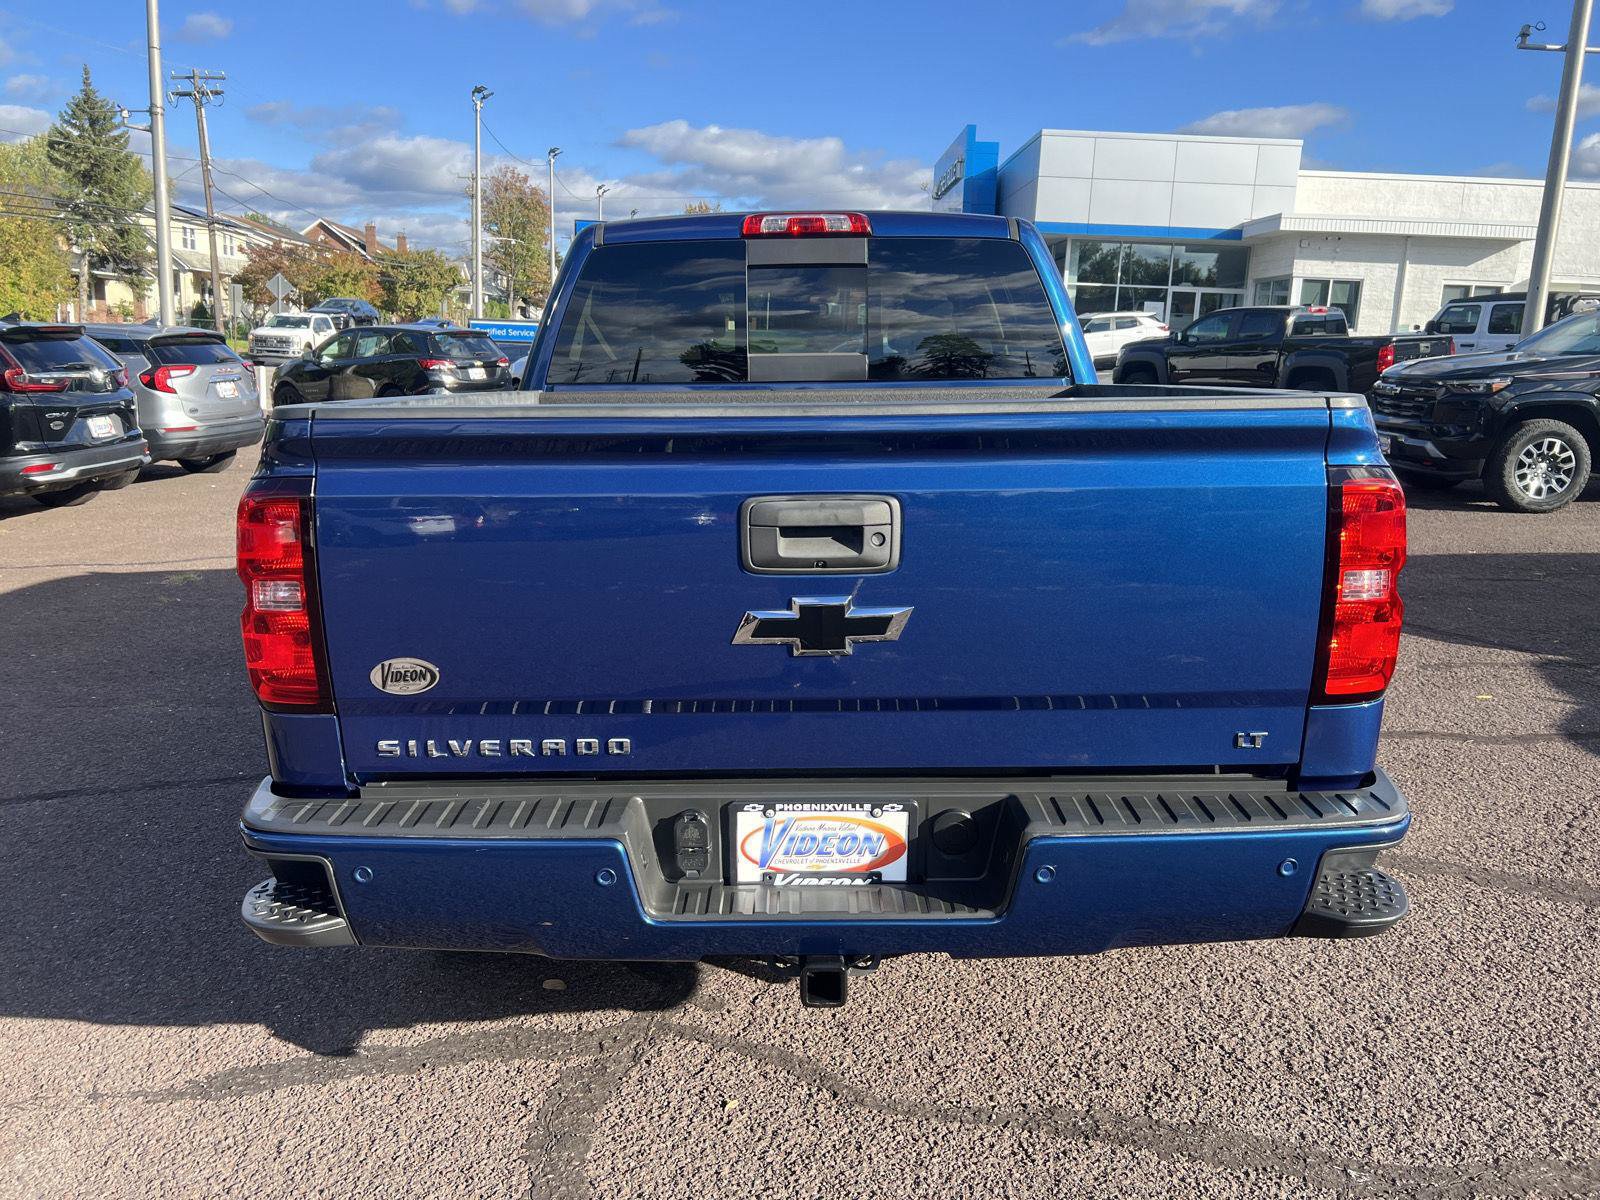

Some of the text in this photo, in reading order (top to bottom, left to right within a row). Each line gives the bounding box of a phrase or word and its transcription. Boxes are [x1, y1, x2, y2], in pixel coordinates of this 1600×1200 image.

[508, 328, 535, 337] Service
[381, 662, 427, 690] VIDEON
[376, 738, 632, 758] SILVERADO
[1236, 731, 1269, 749] LT
[775, 803, 872, 812] PHOENIXVILLE
[758, 816, 886, 869] VIDEON
